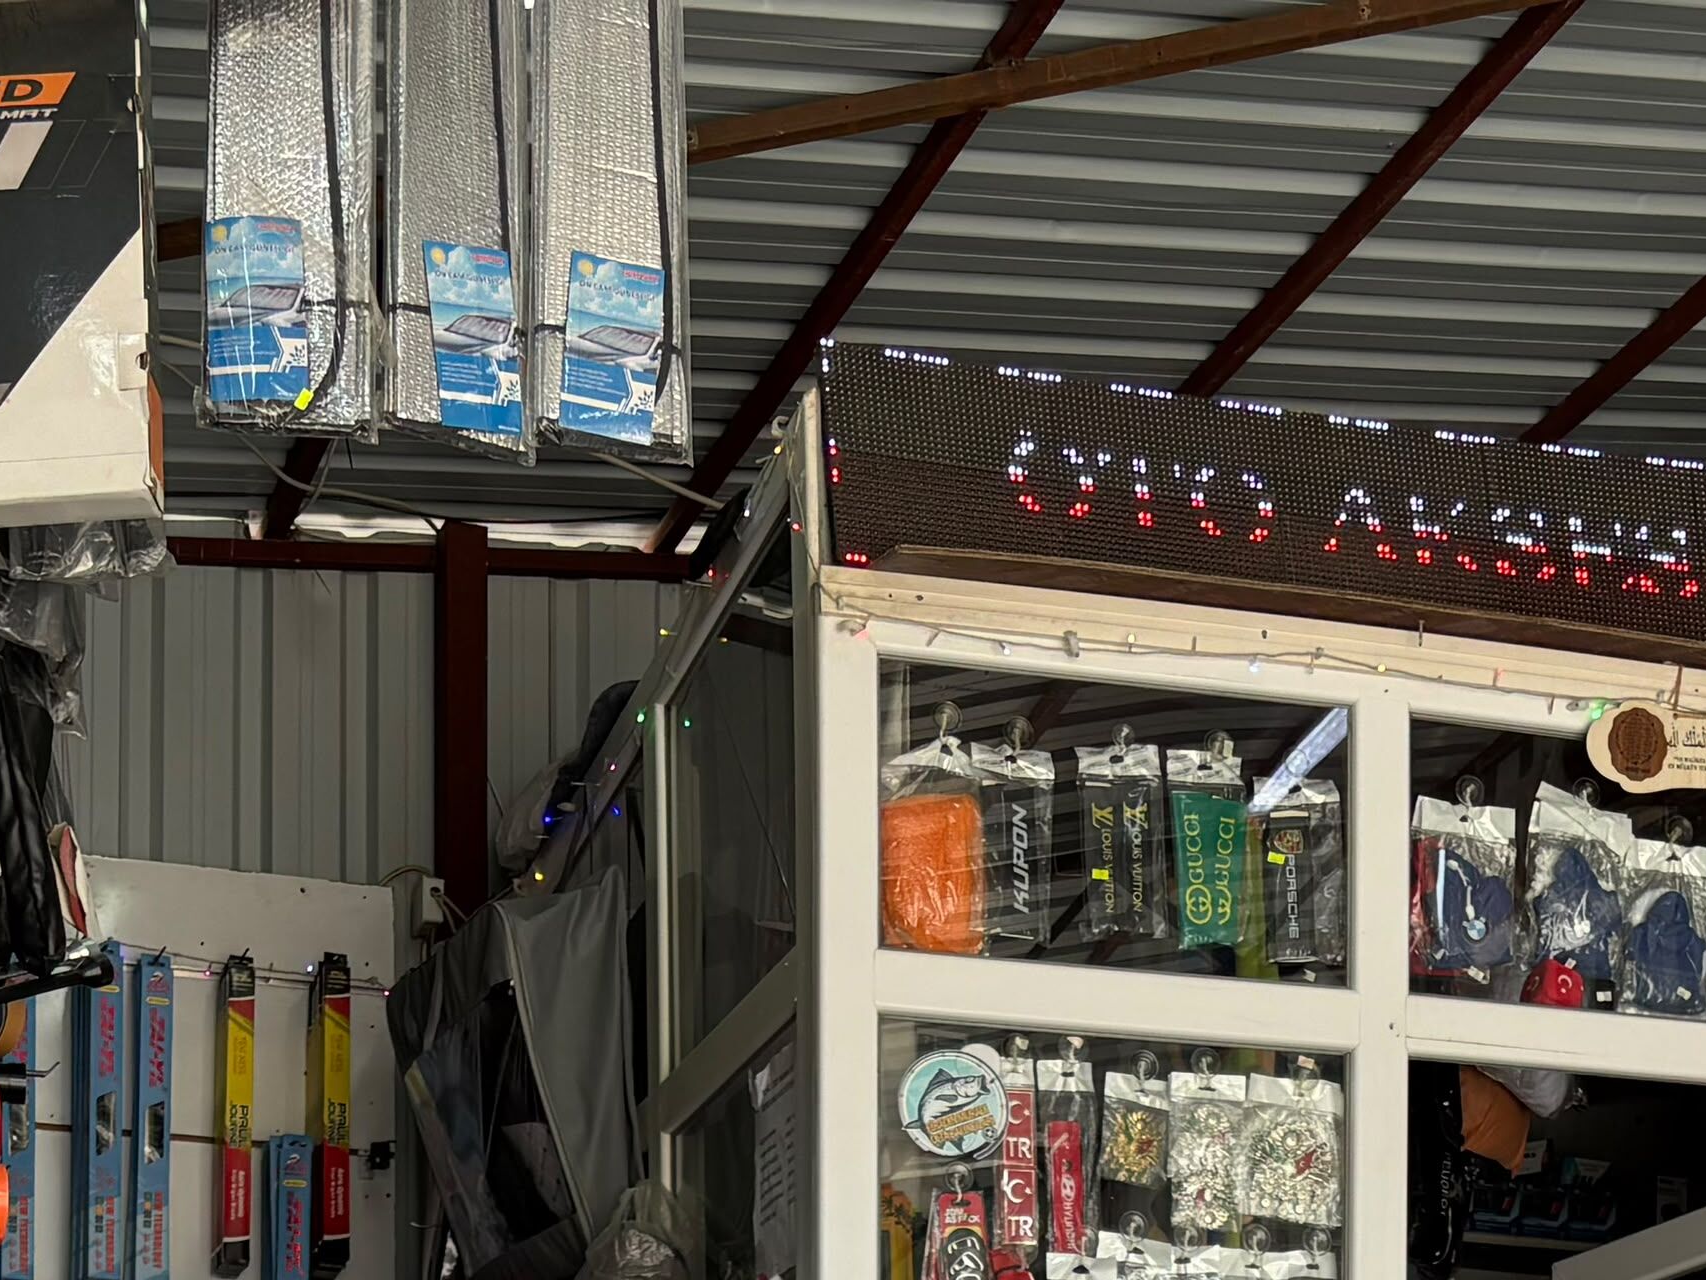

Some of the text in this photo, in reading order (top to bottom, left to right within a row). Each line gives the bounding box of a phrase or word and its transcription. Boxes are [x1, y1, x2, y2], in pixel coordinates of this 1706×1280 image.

[0, 108, 59, 122] MAT
[1013, 804, 1030, 915] KUPON
[1102, 829, 1113, 863] LOUIS
[1188, 813, 1202, 884] GUCCI
[1132, 859, 1144, 913] VUITTON
[1285, 853, 1299, 940] PORSCHE
[1005, 1136, 1033, 1159] TR
[1007, 1215, 1034, 1238] TR
